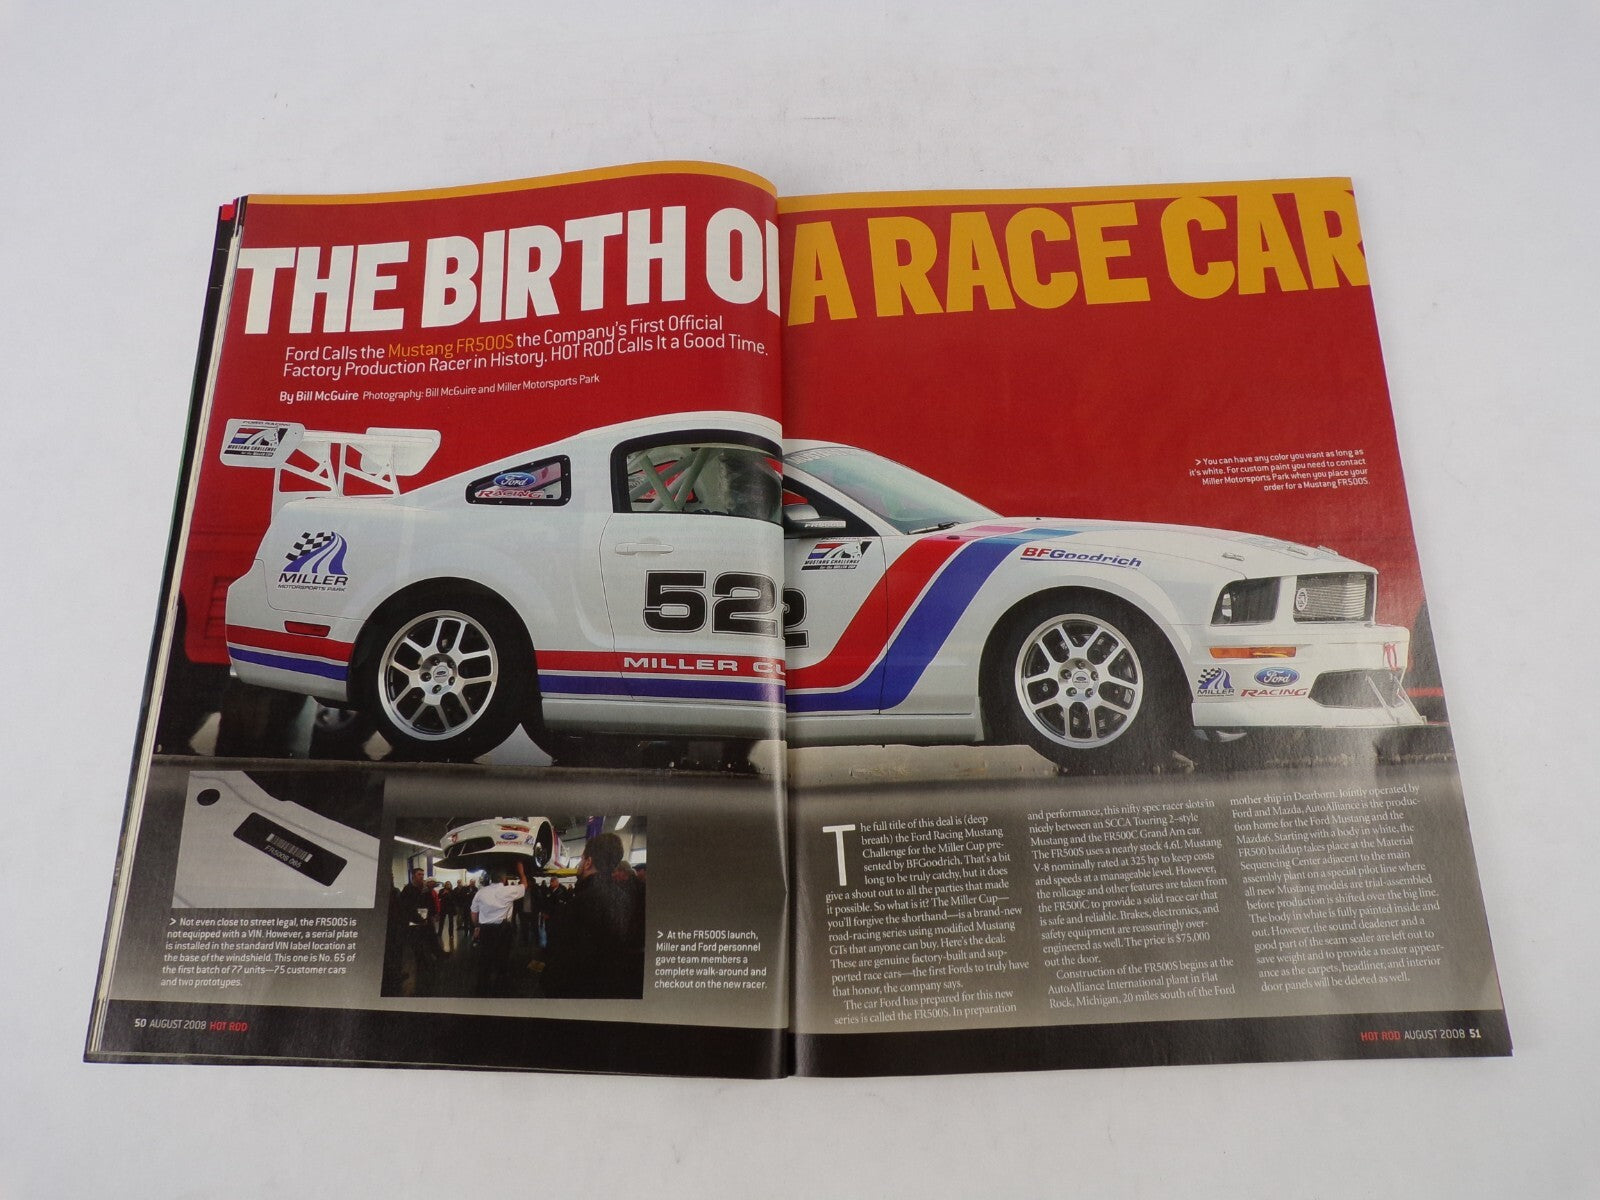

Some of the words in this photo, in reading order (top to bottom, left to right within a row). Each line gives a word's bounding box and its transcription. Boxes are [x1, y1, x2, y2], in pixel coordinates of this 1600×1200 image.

[787, 221, 858, 325] A
[867, 202, 1150, 317] RACE
[1160, 192, 1370, 299] CAR
[236, 241, 409, 334] THE
[422, 206, 686, 328] BIRTH
[285, 346, 319, 360] Ford
[322, 345, 357, 360] Calls
[360, 345, 385, 359] the
[388, 344, 453, 358] Mustang
[456, 333, 514, 352] FR500S
[516, 332, 540, 347] the
[544, 322, 626, 346] Company's
[630, 319, 664, 334] First
[668, 316, 722, 331] Official
[283, 363, 341, 380] Factory
[344, 360, 425, 375] Production
[429, 357, 472, 371] Racer
[474, 357, 486, 368] in
[490, 352, 547, 368] History.
[551, 345, 577, 360] HOT
[583, 342, 614, 357] ROD
[617, 338, 653, 353] Calls
[657, 336, 666, 349] It
[670, 337, 679, 349] a
[683, 334, 724, 348] Good
[728, 333, 768, 355] Time.
[279, 391, 294, 404] By
[296, 390, 313, 401] Bill
[314, 390, 359, 401] McGuire
[362, 390, 424, 401] Photography:
[425, 387, 439, 397] Bill
[440, 385, 476, 396] McGuire
[478, 383, 495, 393] and
[496, 382, 521, 391] Miller
[522, 377, 577, 389] Motorsports
[579, 373, 600, 384] Park
[1254, 455, 1269, 463] any
[1269, 453, 1289, 461] color
[1289, 453, 1304, 462] you
[1335, 449, 1354, 458] long
[1189, 468, 1201, 476] it's
[1201, 467, 1226, 475] white.
[1270, 462, 1290, 474] paint
[1291, 463, 1306, 473] you
[1335, 458, 1366, 466] contact
[1224, 475, 1271, 483] Motorsports
[1290, 470, 1311, 479] when
[1312, 471, 1327, 480] you
[1327, 469, 1349, 479] place
[1349, 468, 1368, 478] your
[1303, 480, 1337, 488] Mustang
[1336, 476, 1370, 486] FR500S.
[1022, 547, 1141, 567] BFGoodrich
[279, 573, 348, 585] MILLER
[643, 570, 778, 638] 52
[624, 657, 738, 672] MILLER
[1241, 688, 1308, 696] RACING
[861, 834, 893, 845] breath)
[895, 833, 909, 842] the
[910, 831, 931, 841] Ford
[933, 830, 963, 841] Racing
[964, 828, 1003, 838] Mustang
[1030, 836, 1069, 846] Mustang
[1069, 833, 1087, 843] and
[1088, 832, 1102, 842] the
[1103, 829, 1138, 841] FR500C
[1139, 827, 1168, 838] Grand
[1169, 827, 1185, 836] Am
[179, 917, 194, 926] Not
[216, 917, 238, 926] close
[276, 917, 298, 928] legal,
[299, 917, 314, 926] the
[315, 917, 348, 926] FR500S
[349, 918, 356, 926] is
[666, 930, 676, 939] At
[677, 930, 691, 939] the
[693, 930, 726, 939] FR500S
[727, 930, 758, 940] launch,
[656, 942, 679, 951] Miller
[680, 942, 696, 951] and
[698, 942, 716, 951] Ford
[718, 942, 760, 953] personnel
[655, 956, 676, 966] gave
[677, 955, 699, 964] team
[700, 955, 741, 964] members
[654, 967, 694, 978] complete
[695, 966, 748, 976] walk-around
[750, 966, 766, 976] and
[160, 977, 177, 986] and
[194, 978, 242, 988] prototypes.
[654, 979, 693, 988] checkout
[707, 979, 721, 988] the
[1261, 982, 1283, 991] door
[1284, 979, 1313, 992] panels
[1313, 978, 1330, 987] will
[1331, 977, 1342, 986] be
[1344, 975, 1377, 985] deleted
[1378, 975, 1388, 984] as
[134, 1018, 147, 1027] 50
[149, 1019, 182, 1029] AUGUST
[184, 1020, 206, 1030] 2008
[210, 1022, 226, 1030] HOT
[229, 1022, 248, 1032] ROD
[1360, 1032, 1378, 1041] HOT
[1382, 1031, 1400, 1041] ROD
[1404, 1030, 1437, 1040] AUGUST
[1440, 1029, 1465, 1038] 2008
[1469, 1029, 1481, 1038] 51
